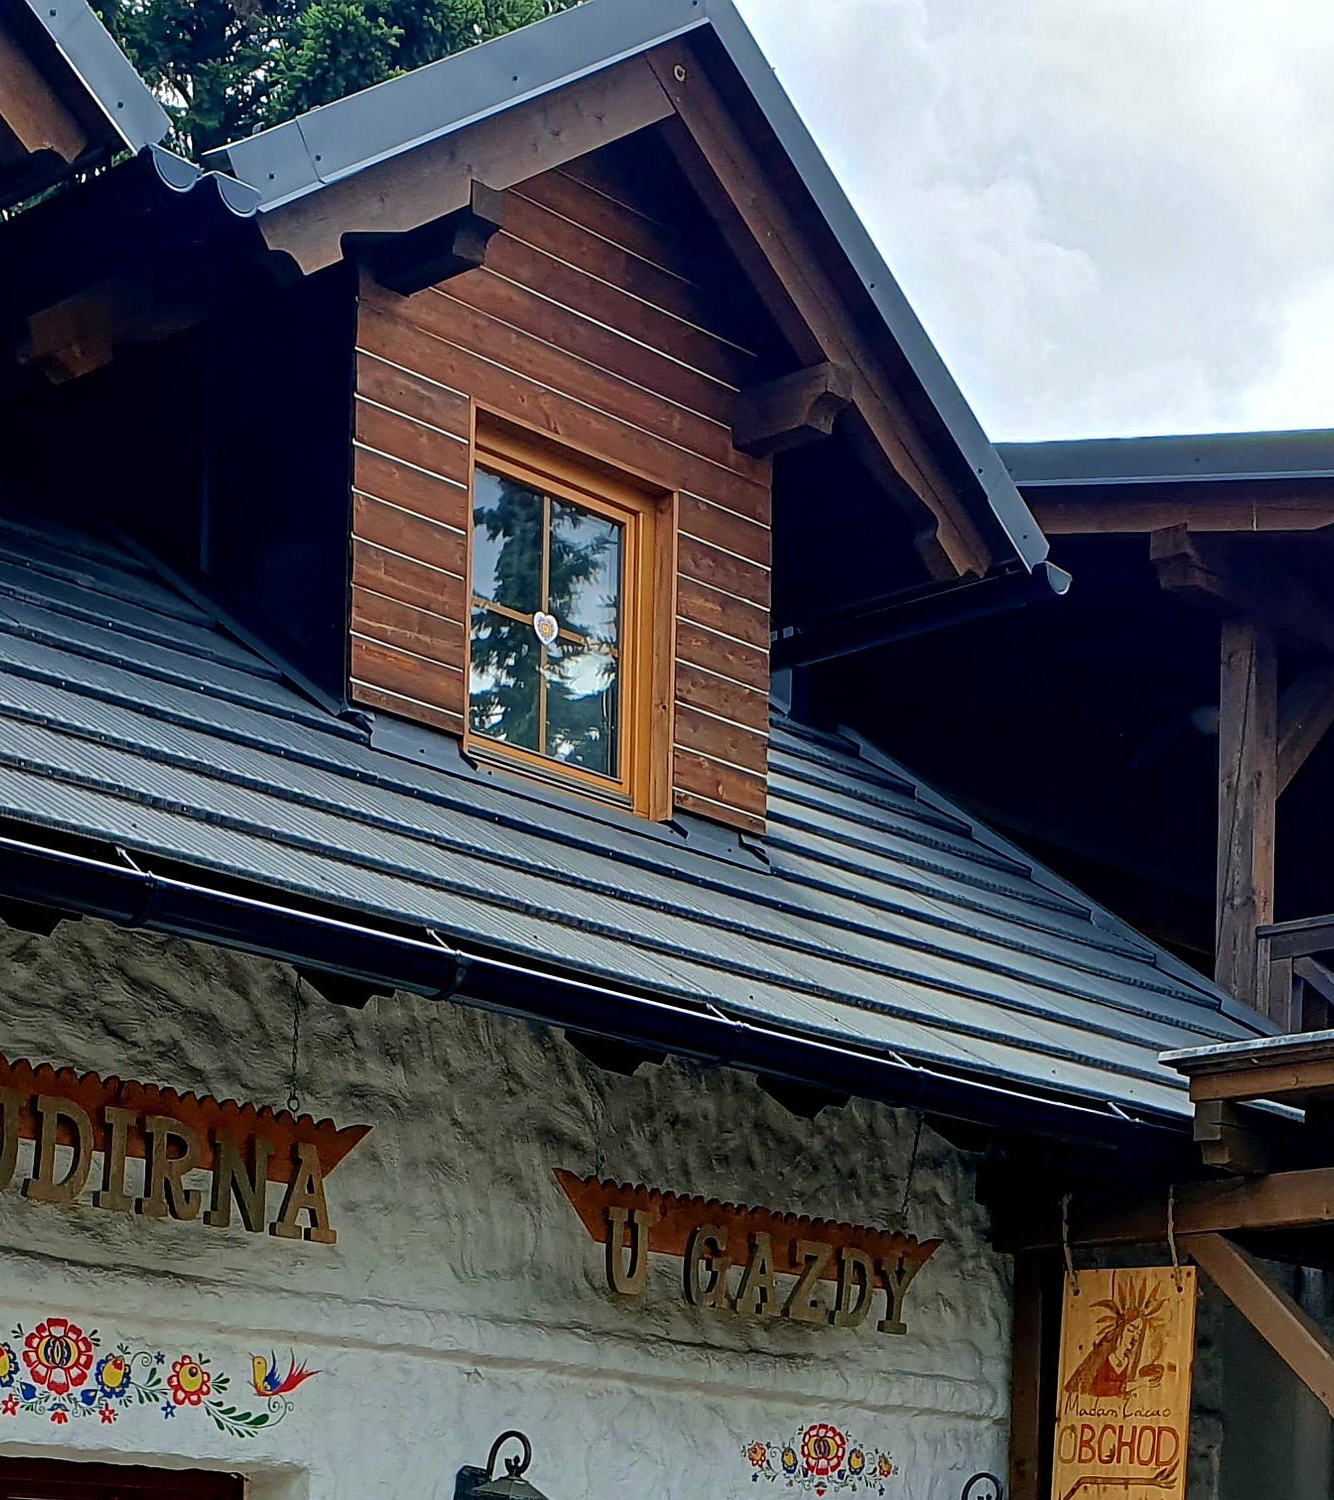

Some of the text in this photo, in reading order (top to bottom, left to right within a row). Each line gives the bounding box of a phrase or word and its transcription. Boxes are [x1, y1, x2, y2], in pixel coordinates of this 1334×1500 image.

[604, 1206, 923, 1336] U GAZDY
[1058, 1423, 1180, 1466] OBCHOD
